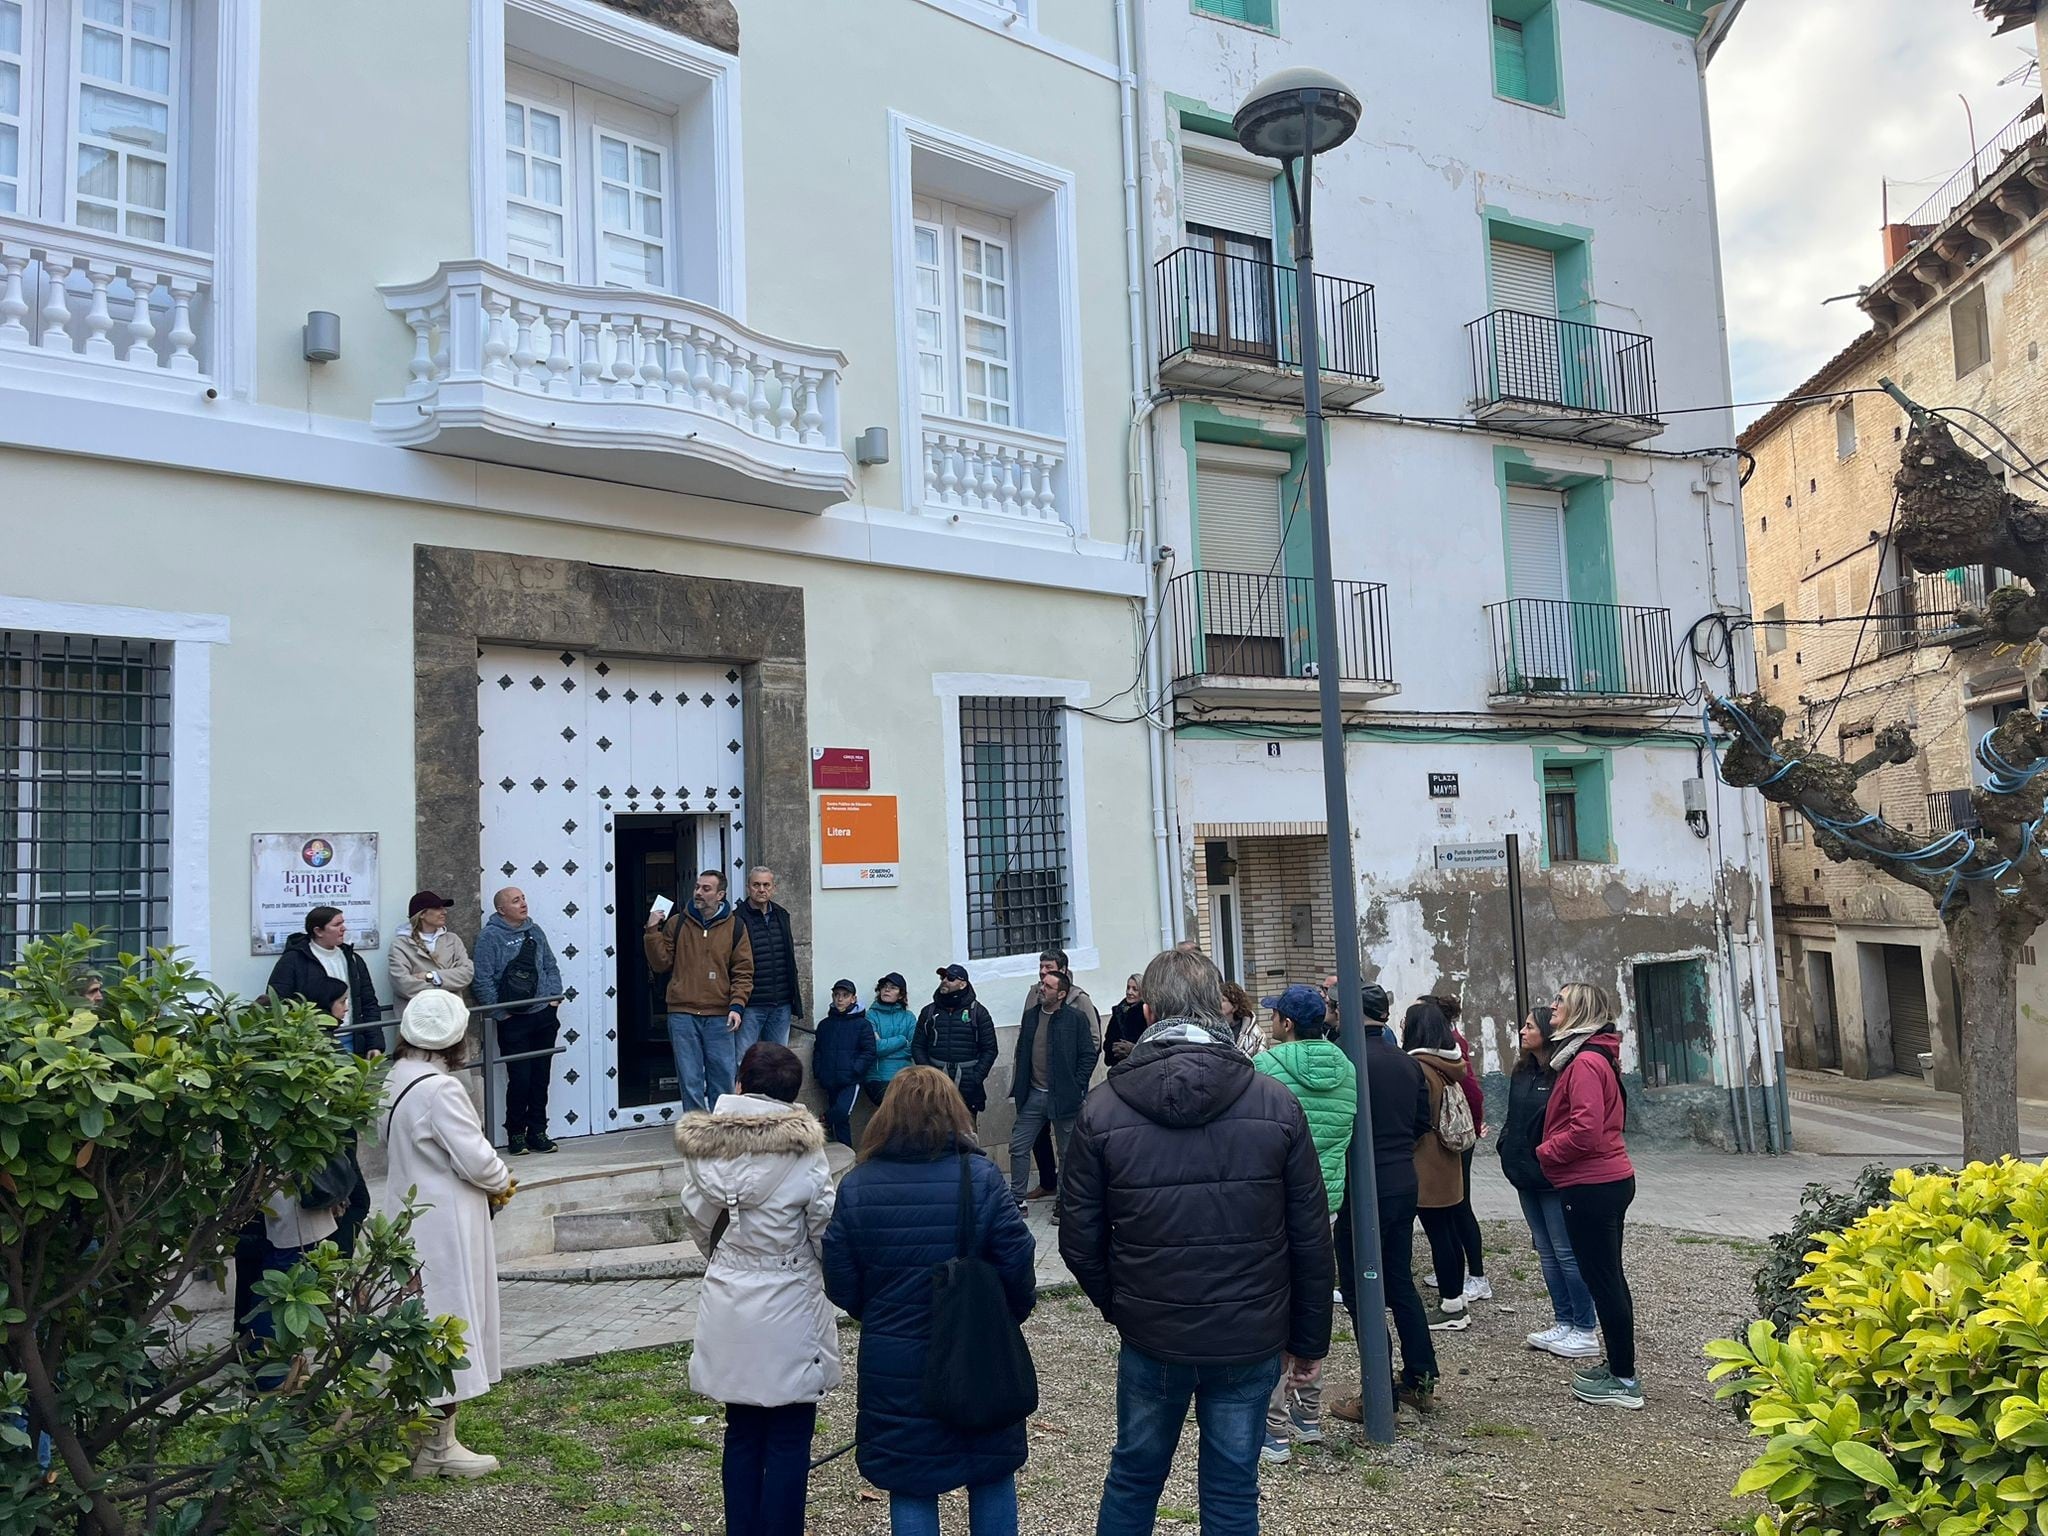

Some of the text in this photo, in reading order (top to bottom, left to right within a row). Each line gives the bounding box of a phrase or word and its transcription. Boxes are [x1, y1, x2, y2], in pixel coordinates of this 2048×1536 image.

[1271, 743, 1278, 757] 8
[1433, 784, 1458, 795] MAYOR
[827, 827, 851, 837] Litera
[282, 870, 352, 890] Tamarite
[283, 884, 294, 893] de
